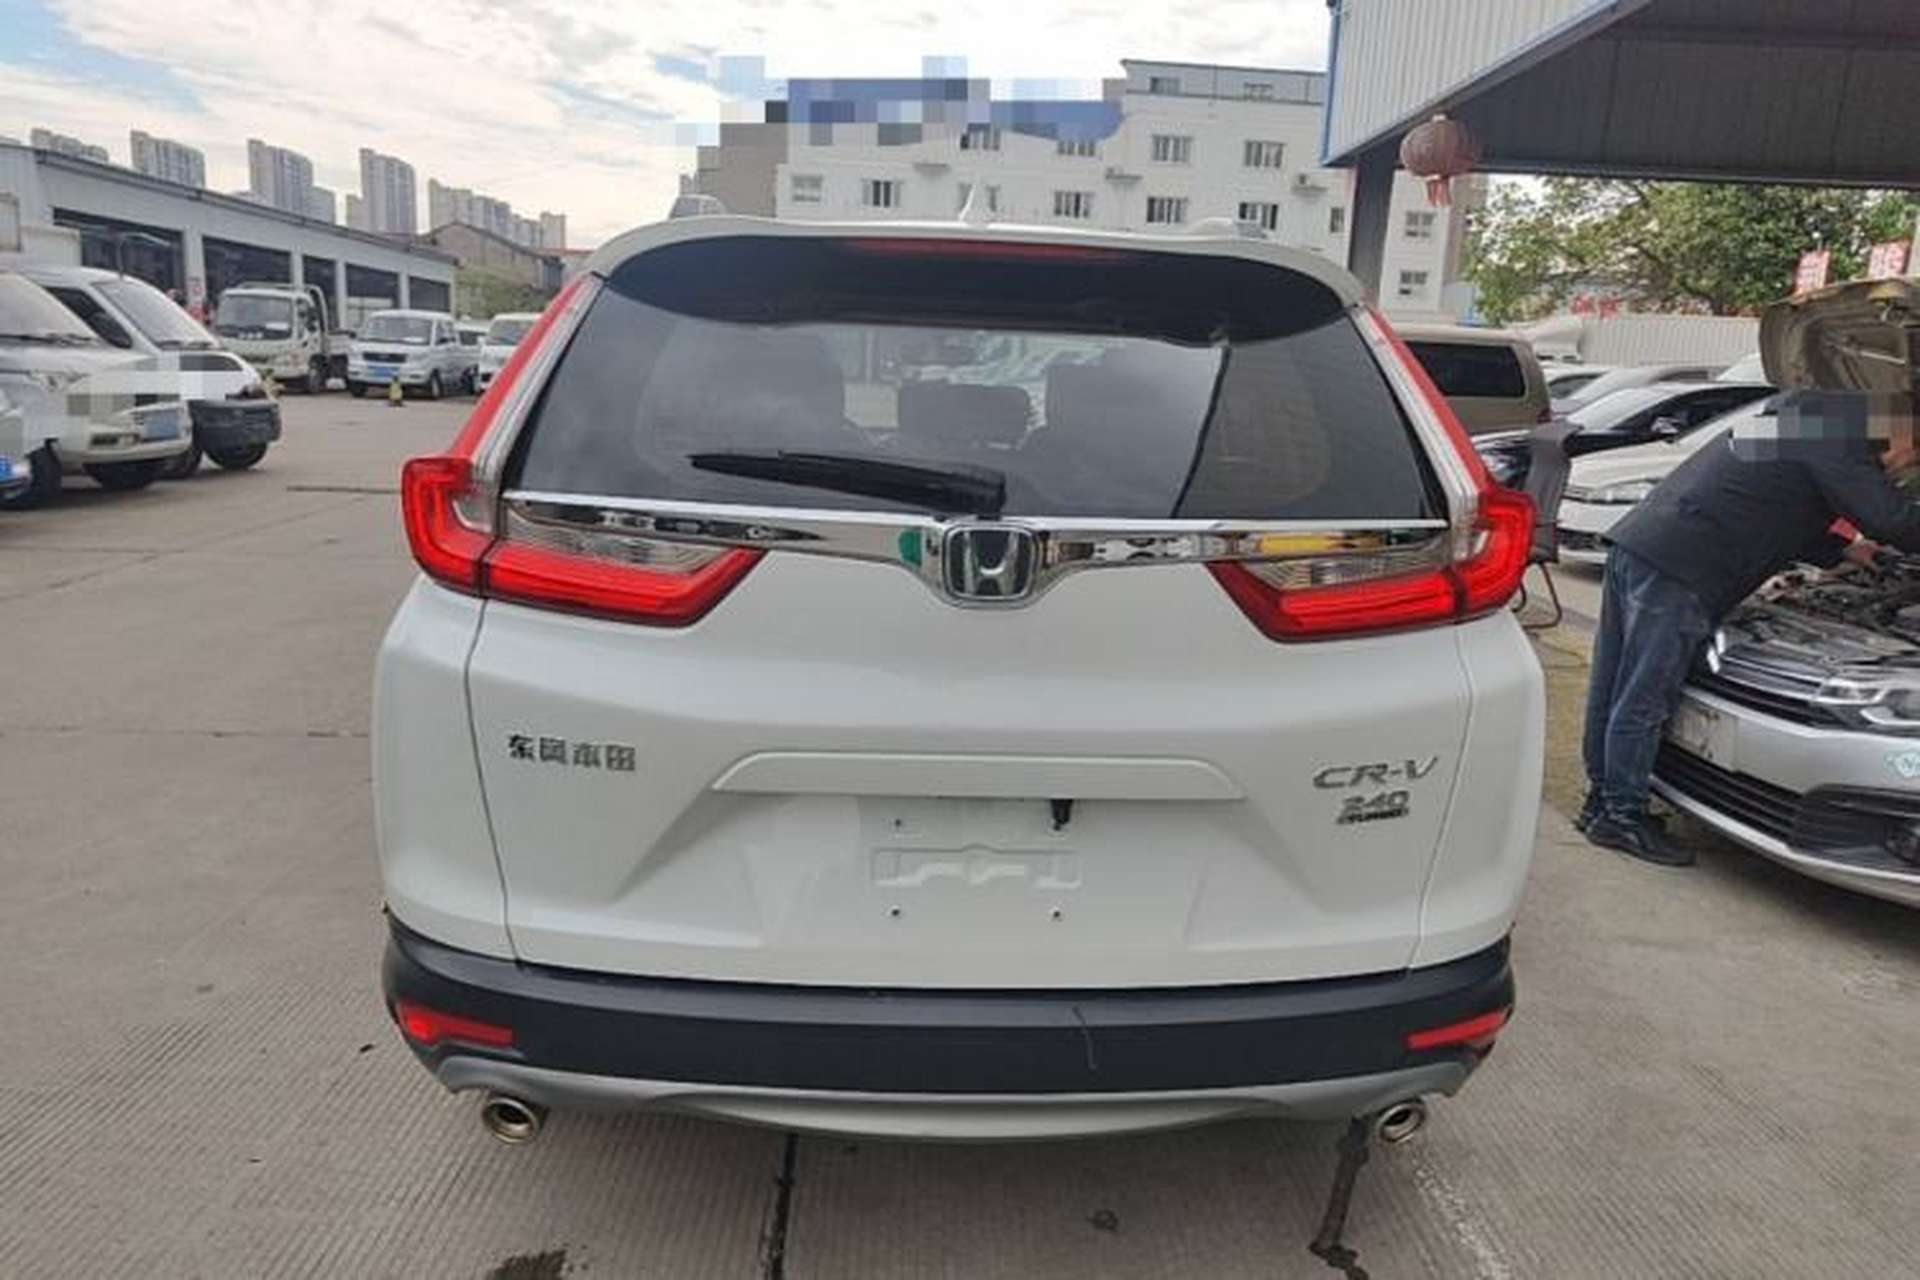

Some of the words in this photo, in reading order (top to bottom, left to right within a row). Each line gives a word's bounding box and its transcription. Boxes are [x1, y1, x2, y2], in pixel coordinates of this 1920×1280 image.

[508, 733, 636, 772] 东风本田
[1313, 756, 1438, 789] CR-V
